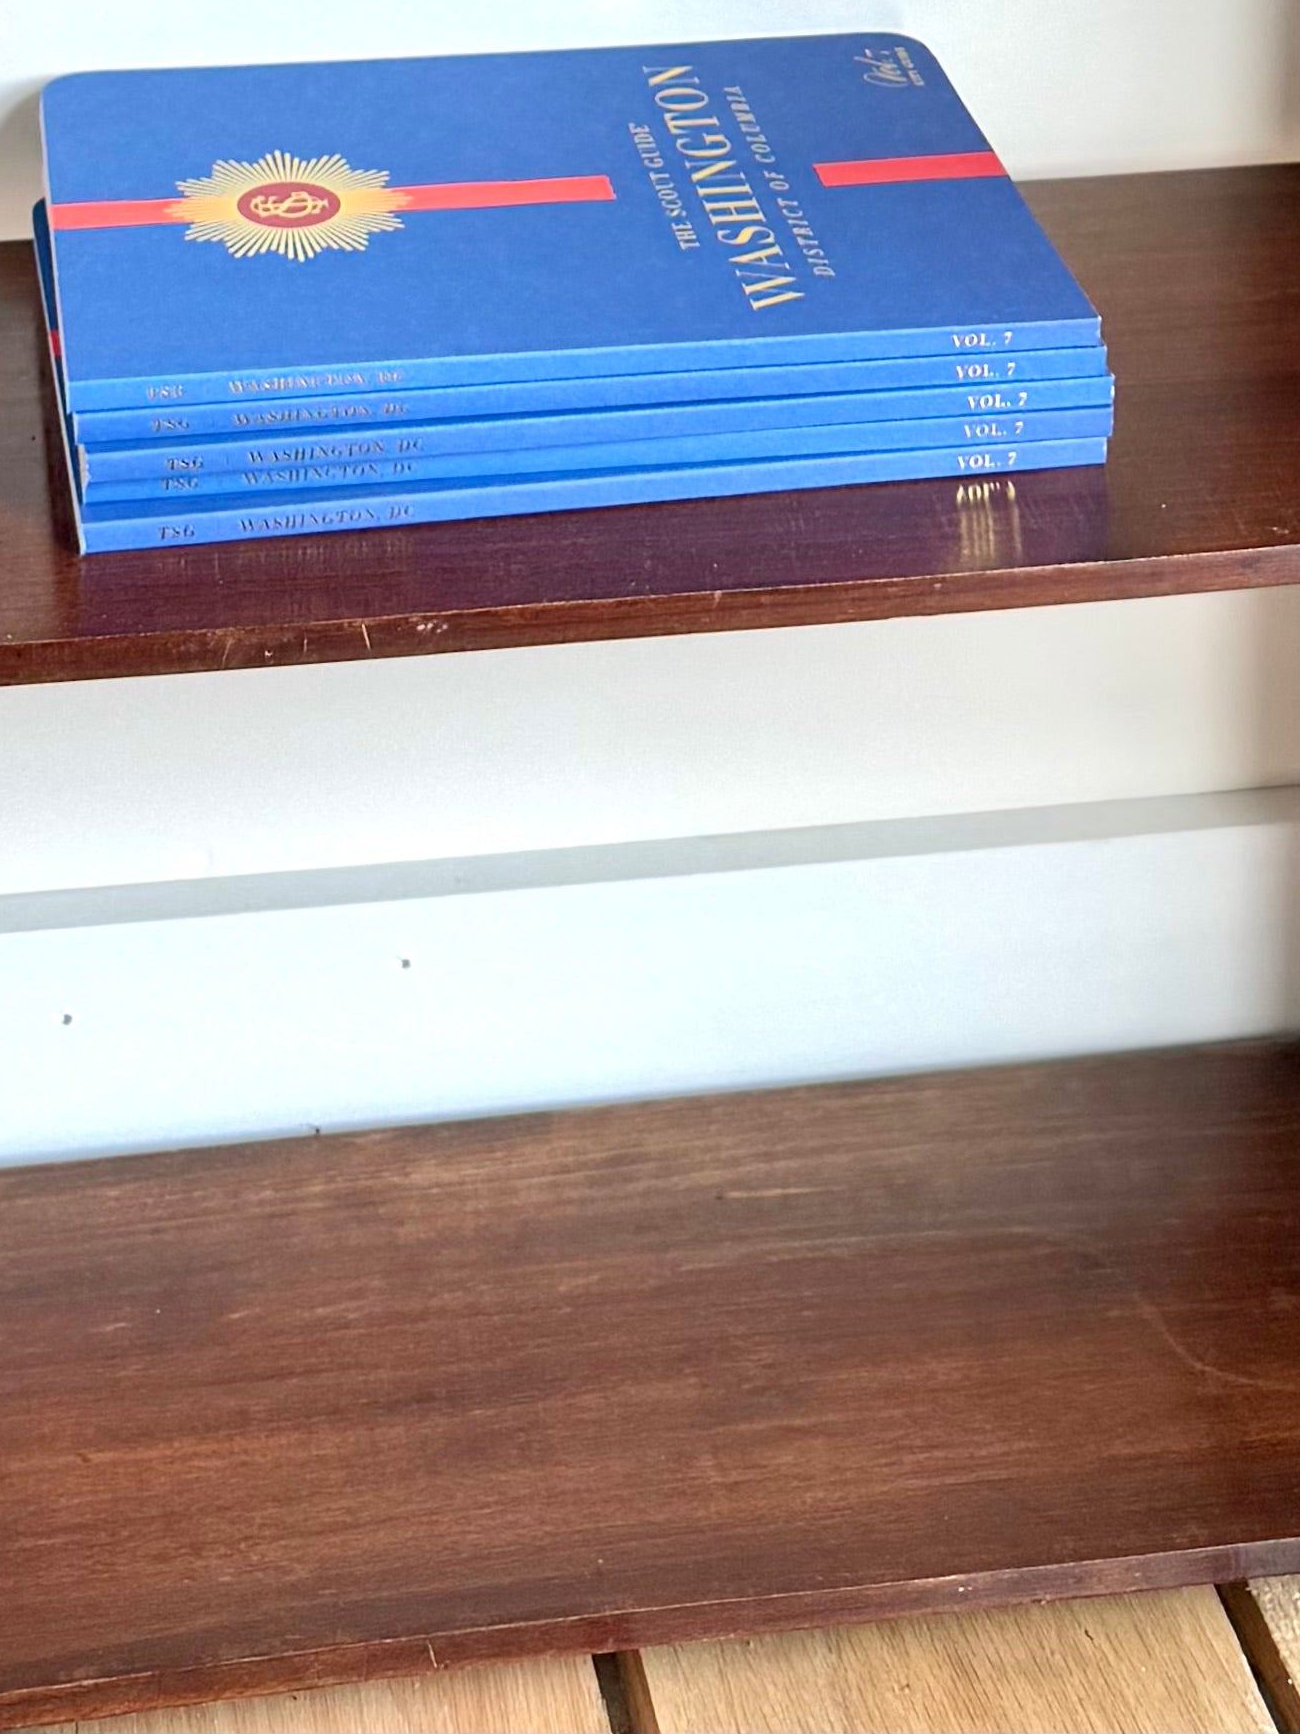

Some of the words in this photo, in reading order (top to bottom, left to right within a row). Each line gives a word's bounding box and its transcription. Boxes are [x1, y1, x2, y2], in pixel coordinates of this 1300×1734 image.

[723, 85, 776, 164] COLUMBIA
[628, 122, 664, 168] GUIDE
[642, 65, 806, 311] WASHINGTON
[649, 171, 687, 217] SCOUT
[763, 169, 790, 191] OF
[671, 221, 700, 250] THE
[776, 197, 836, 277] DISTRICT
[952, 333, 997, 348] VOL.
[1003, 331, 1012, 345] 7
[955, 363, 999, 380] VOL.
[1006, 362, 1016, 376] 7
[967, 393, 1011, 410] VOL.
[1018, 391, 1028, 406] 7
[963, 423, 1007, 438] VOL.
[1014, 421, 1024, 435] 7
[166, 456, 204, 471] TSG
[398, 437, 425, 453] DC
[393, 461, 419, 475] DC
[957, 454, 1001, 469] VOL.
[1007, 451, 1017, 465] 7
[158, 524, 195, 541] TSG
[389, 504, 416, 520] DC
